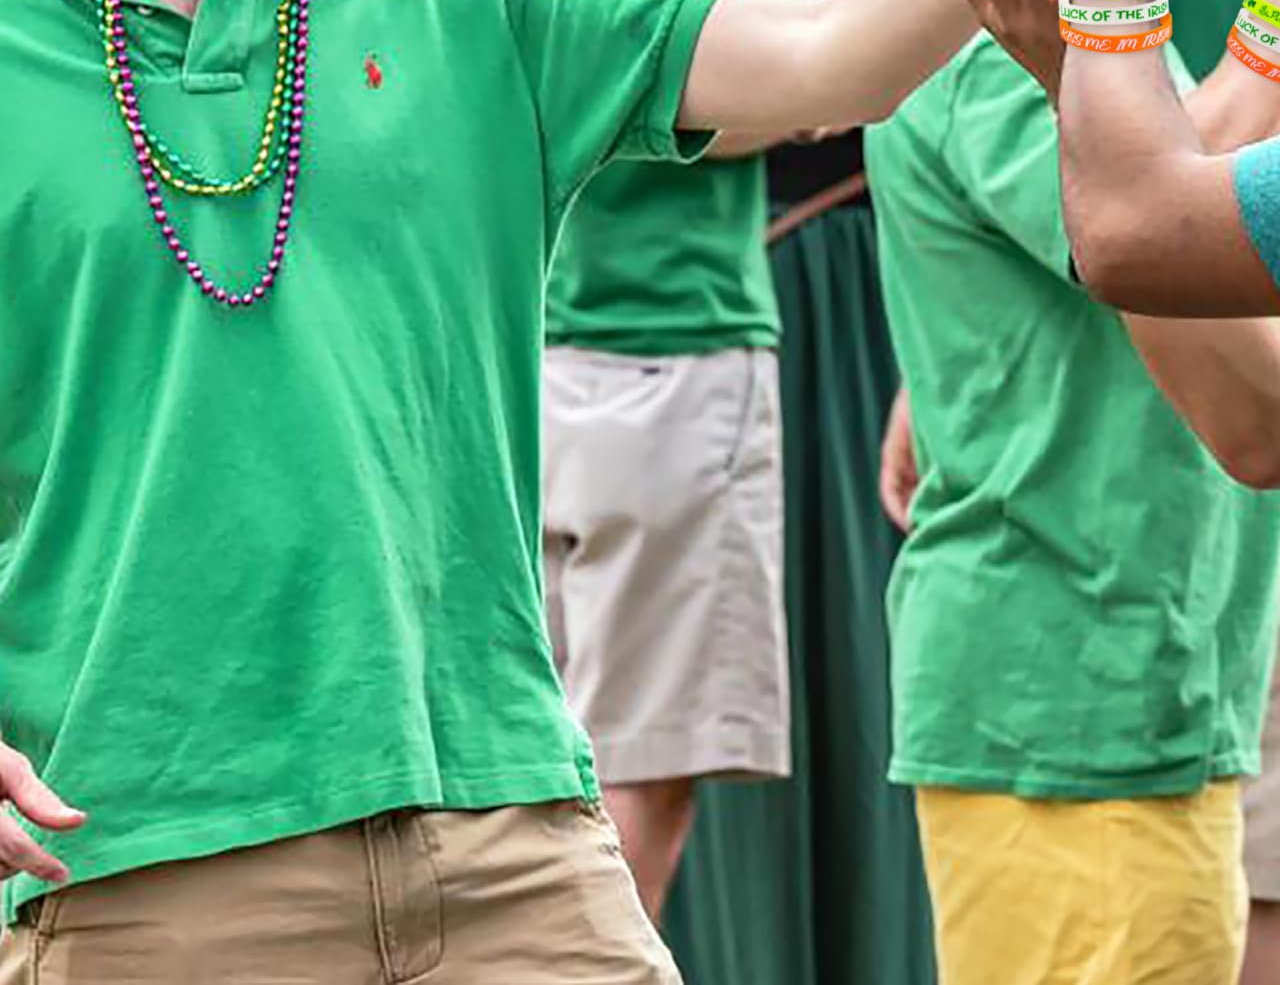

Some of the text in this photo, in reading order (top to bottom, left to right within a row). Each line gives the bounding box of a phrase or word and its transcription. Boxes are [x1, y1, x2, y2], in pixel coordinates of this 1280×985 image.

[1091, 10, 1112, 22] OF
[1115, 8, 1145, 20] THE
[1085, 36, 1112, 51] ME
[1260, 33, 1279, 47] OF
[1243, 53, 1267, 73] ME
